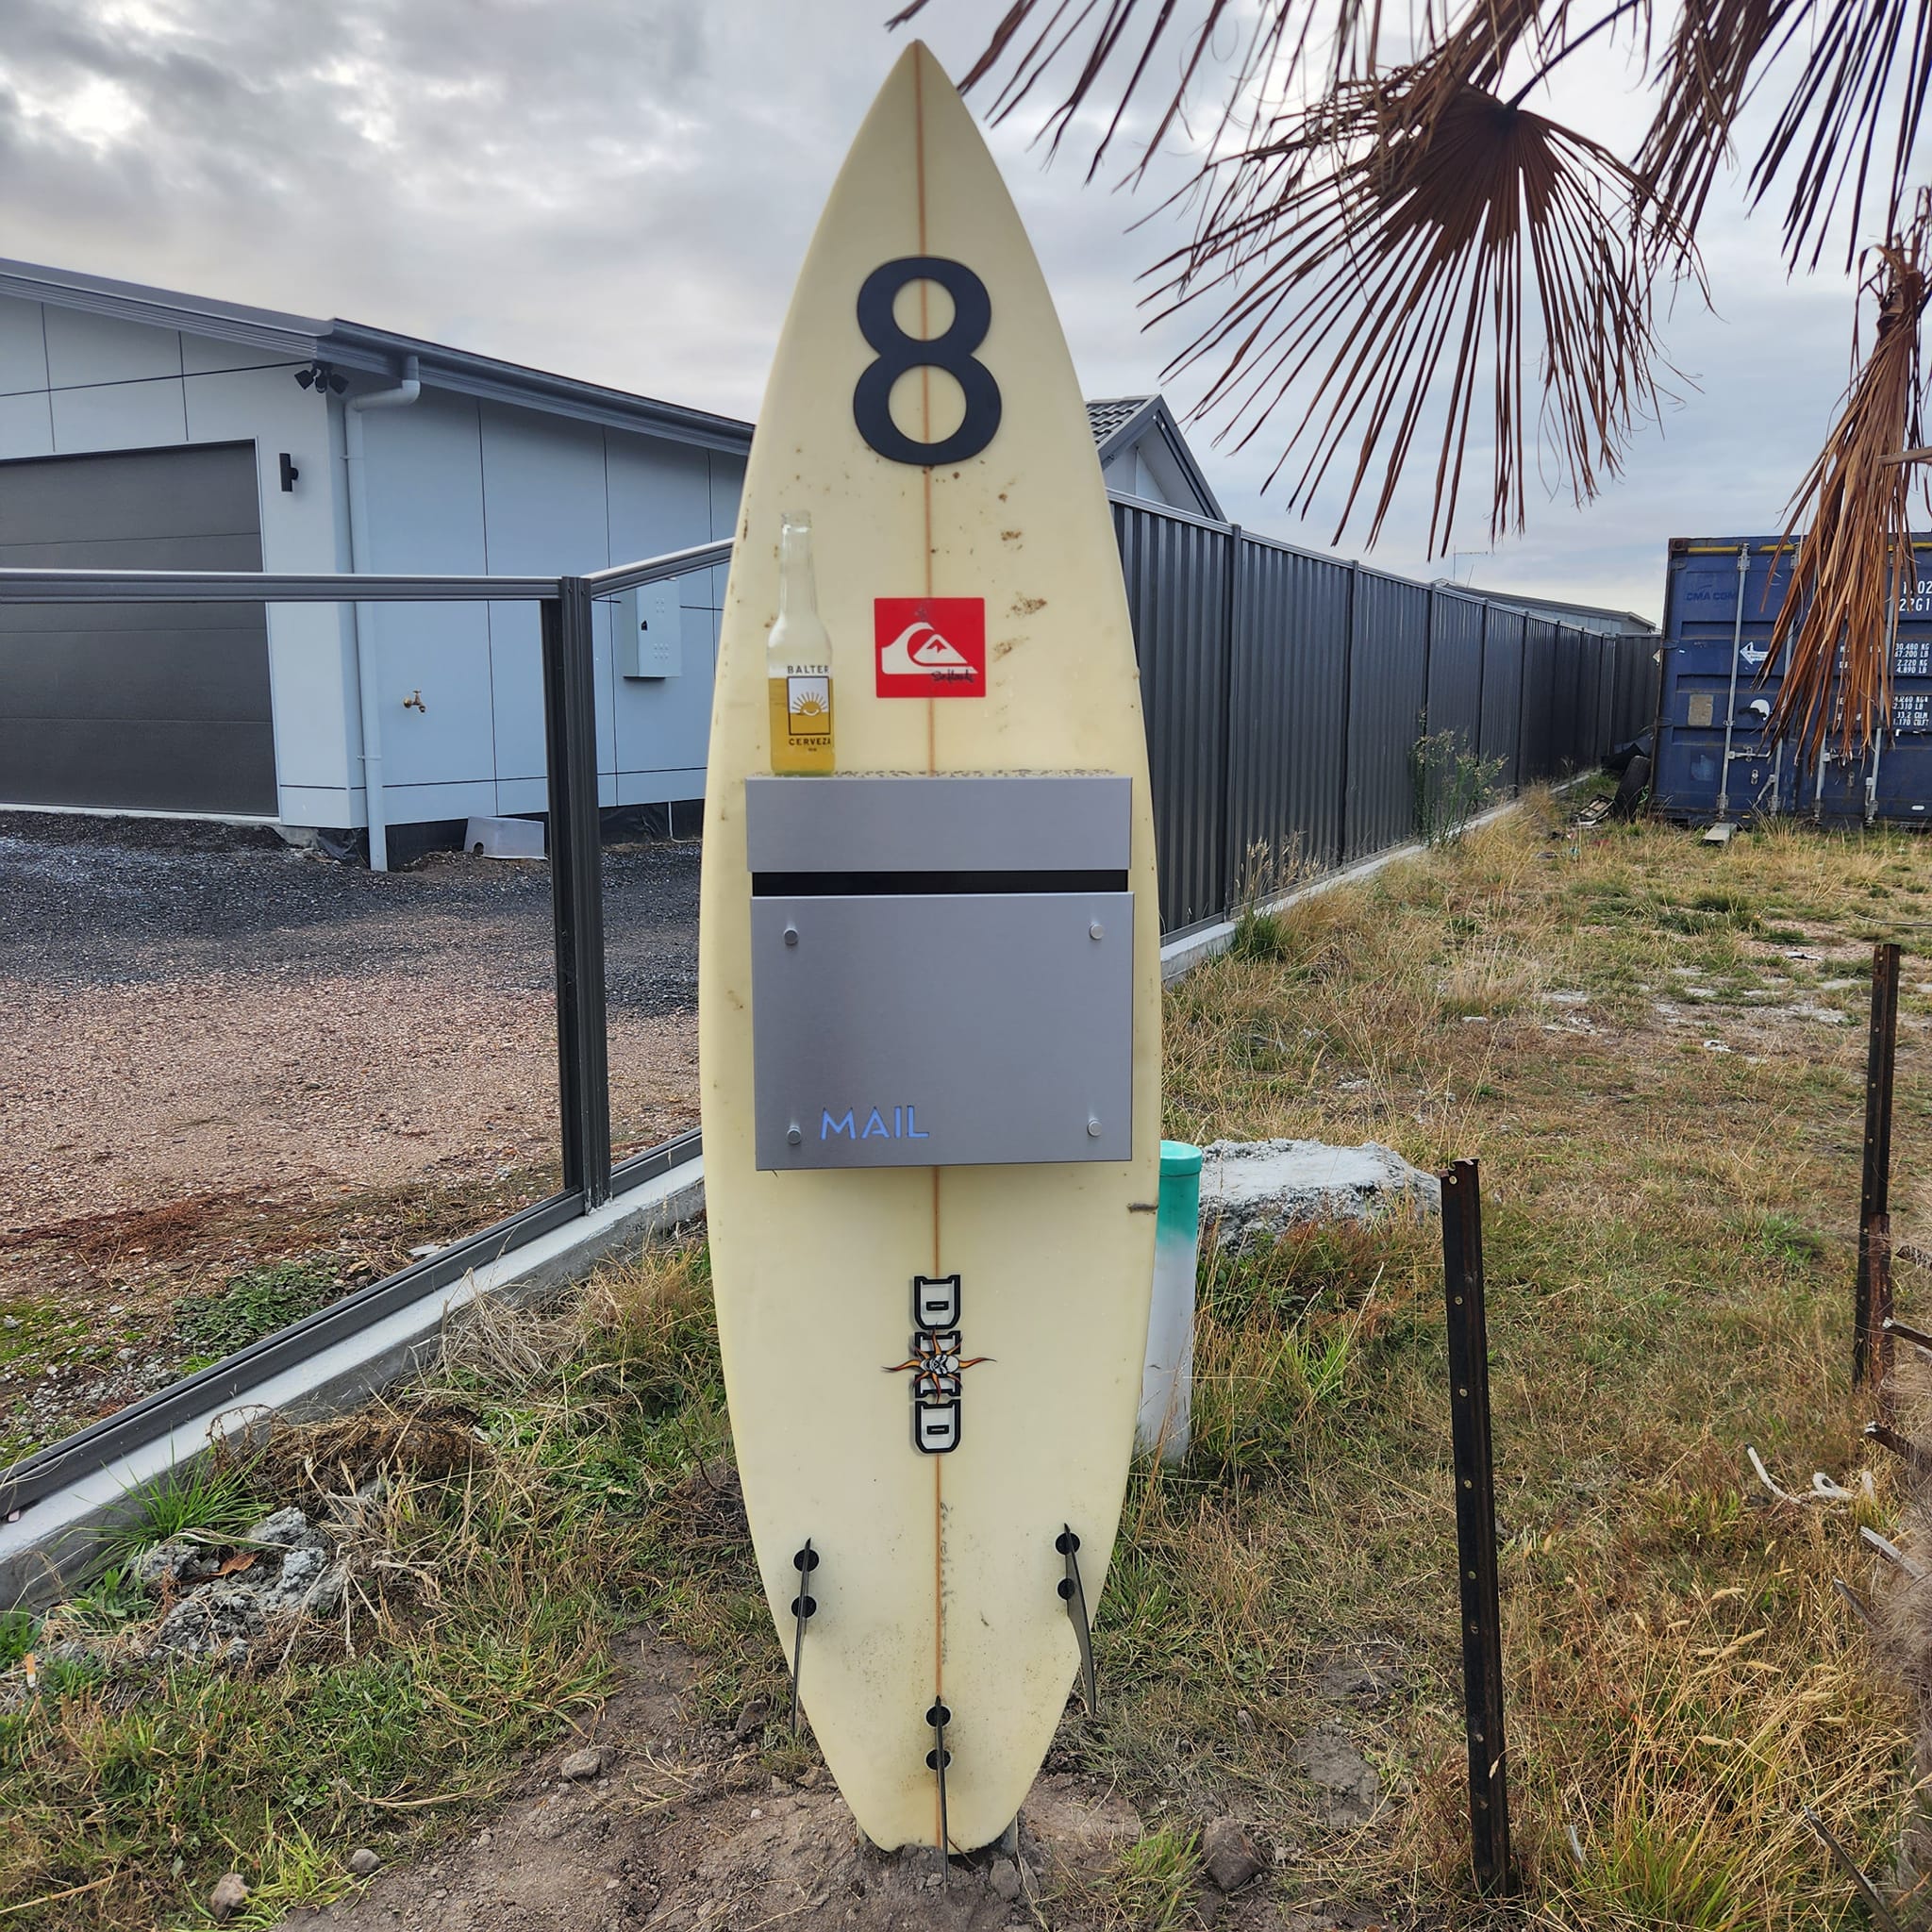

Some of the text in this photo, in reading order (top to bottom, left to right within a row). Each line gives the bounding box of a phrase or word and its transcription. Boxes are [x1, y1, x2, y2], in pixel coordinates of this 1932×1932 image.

[853, 257, 1002, 466] 8
[1686, 591, 1710, 601] CMA
[1921, 642, 1930, 651] KG
[1920, 650, 1929, 658] LB
[1897, 658, 1928, 667] 2.220 KG
[787, 664, 830, 675] BALTER
[1918, 666, 1927, 675] LB
[1896, 710, 1912, 719] 33.2
[820, 1104, 930, 1141] MAIL
